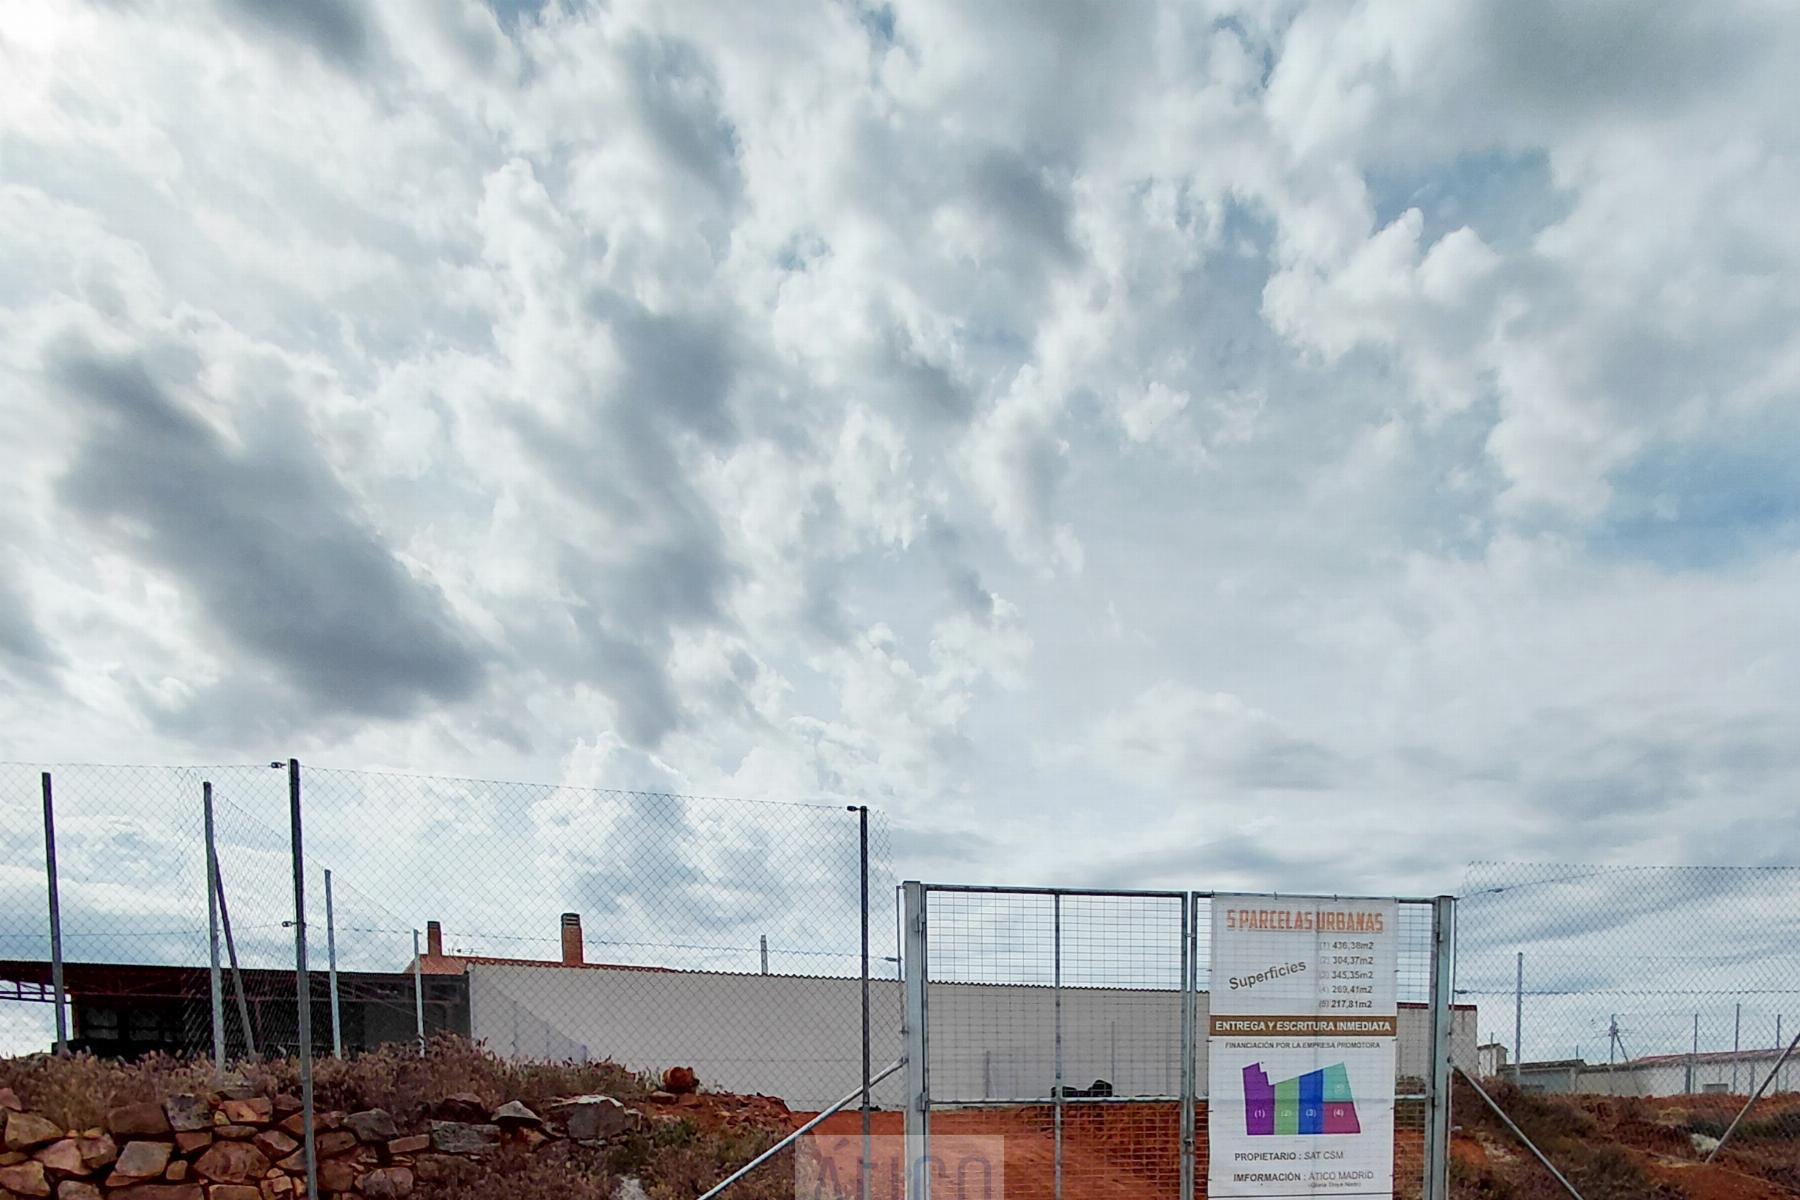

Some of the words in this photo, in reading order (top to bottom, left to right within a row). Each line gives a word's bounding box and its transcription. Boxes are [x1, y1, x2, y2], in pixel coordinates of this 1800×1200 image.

[1239, 909, 1313, 930] PARCELAS
[1316, 911, 1384, 931] URBANAS
[1228, 960, 1307, 990] Superficies
[1215, 1021, 1265, 1031] ENTREGA
[1267, 1021, 1275, 1031] Y
[1276, 1021, 1334, 1031] ESCRITURA
[1336, 1021, 1391, 1031] INMEDIATA
[1225, 1041, 1274, 1049] FINANCIACIÓN
[1254, 1109, 1266, 1119] (1)
[1234, 1152, 1297, 1161] PROPIETARIO
[1304, 1151, 1321, 1160] SAT
[1323, 1151, 1344, 1160] CSM
[1338, 1171, 1374, 1180] MADRID
